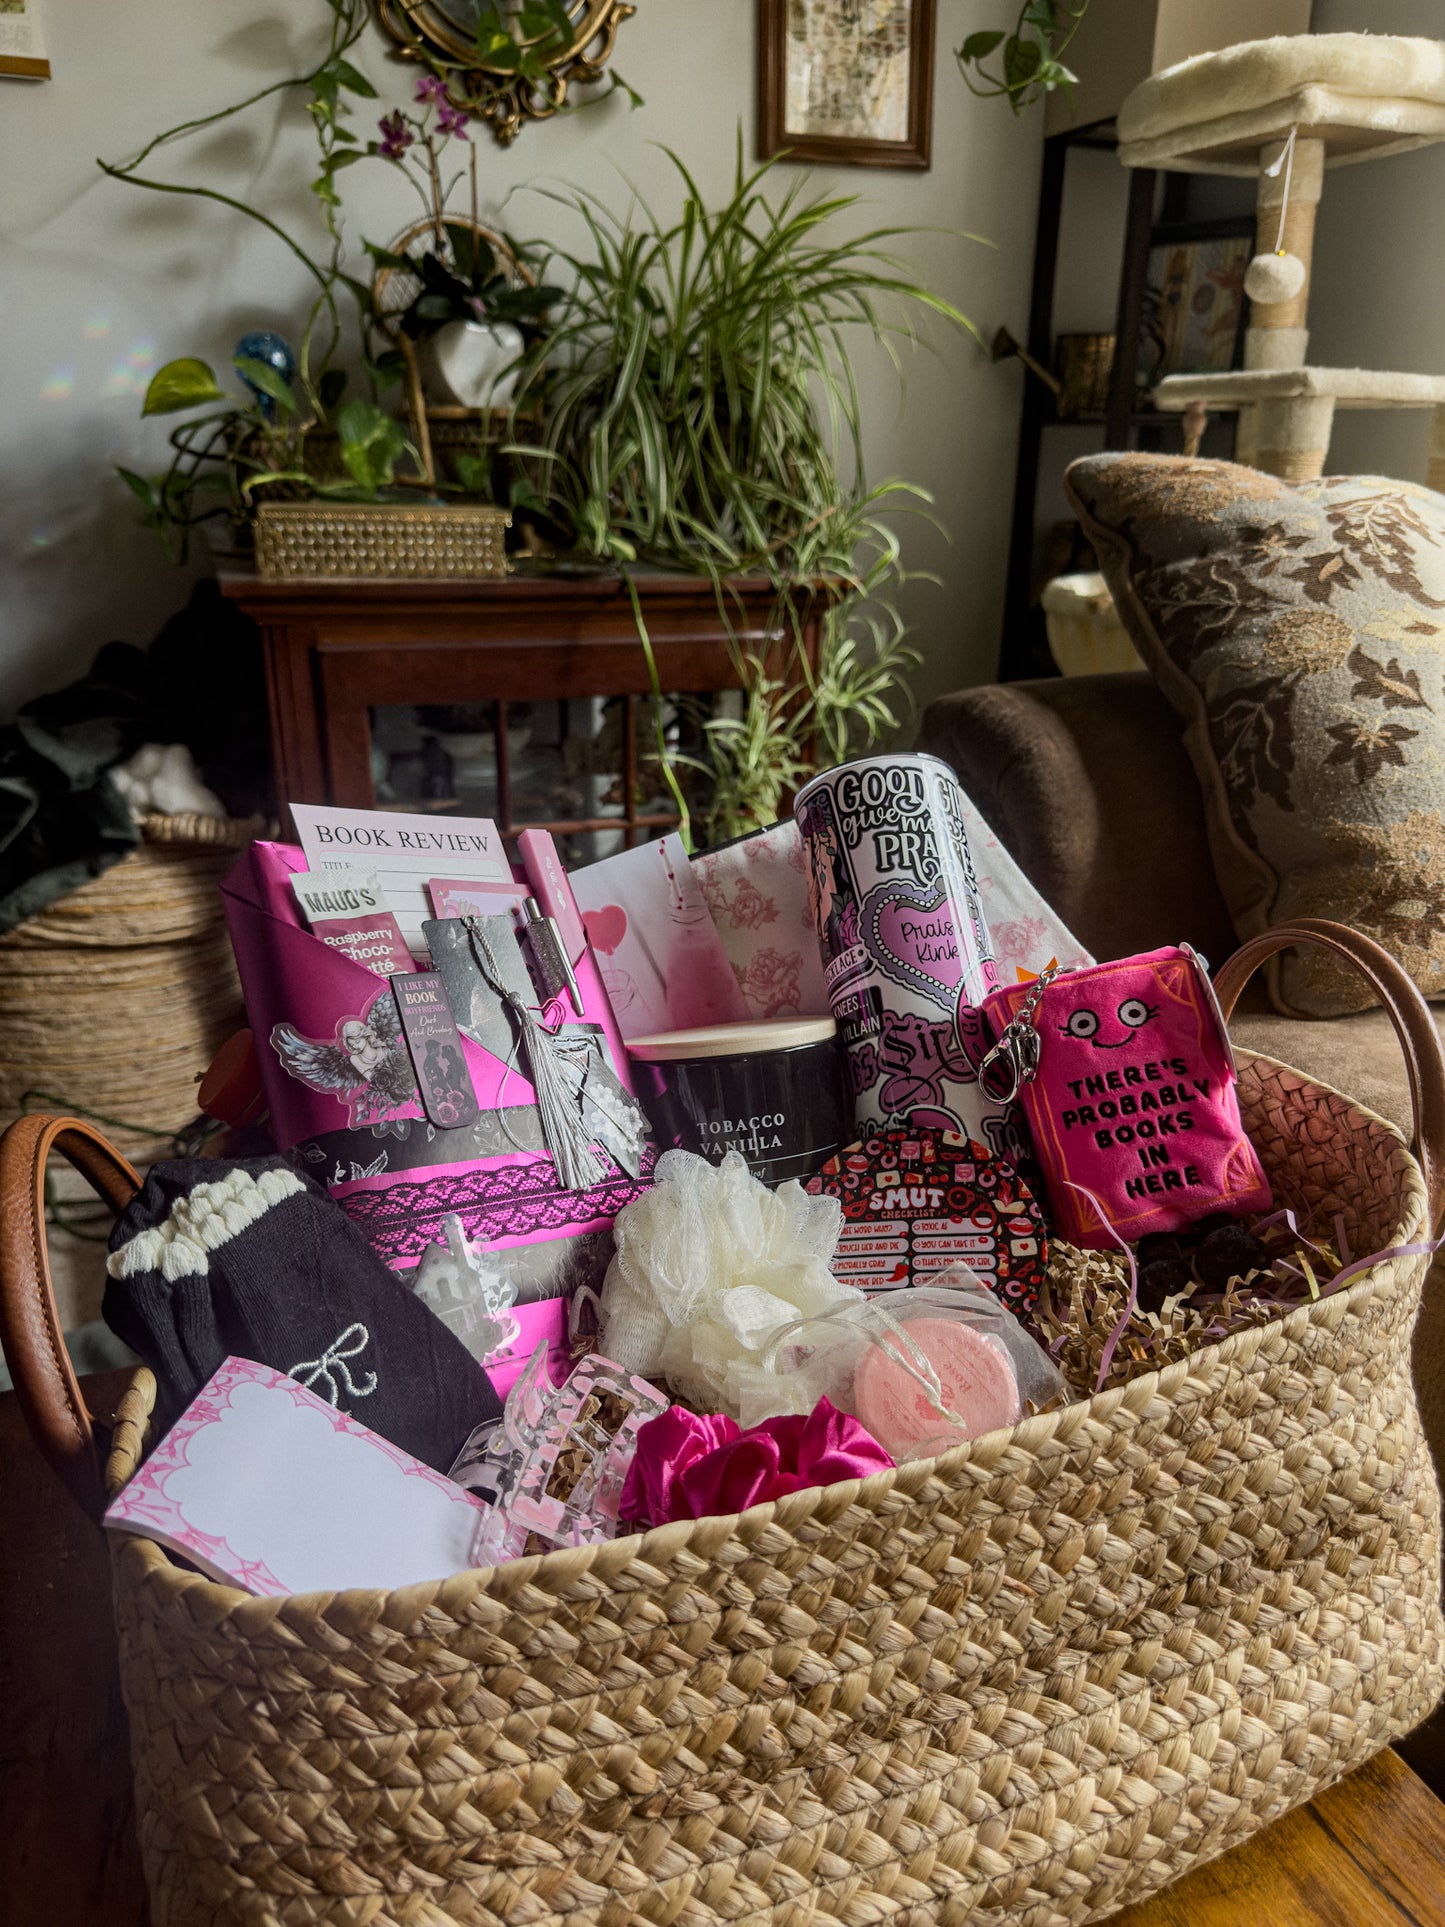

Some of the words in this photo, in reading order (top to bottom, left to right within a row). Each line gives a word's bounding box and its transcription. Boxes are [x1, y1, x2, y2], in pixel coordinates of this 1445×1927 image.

[837, 768, 927, 816] GOOD
[842, 804, 900, 845] give
[901, 815, 938, 833] me
[314, 825, 393, 848] BOOK
[397, 830, 489, 853] REVIEW
[303, 887, 377, 913] MAUD'S
[324, 929, 393, 946] Raspberry
[914, 940, 960, 964] Kink
[404, 981, 425, 991] LIKE
[425, 980, 439, 988] MY
[404, 1004, 447, 1015] BOYFRIENDS
[405, 991, 438, 1005] BOOK
[1066, 1058, 1188, 1100] THERE'S
[1061, 1079, 1209, 1131] PROBABLY
[696, 1113, 785, 1135] TOBACCO
[1094, 1111, 1195, 1149] BOOKS
[700, 1134, 783, 1155] VANILLA
[1137, 1143, 1170, 1168] IN
[1124, 1165, 1202, 1200] HERE
[868, 1187, 945, 1211] SMUT
[881, 1208, 936, 1220] CHECKLIST
[921, 1240, 937, 1249] YOU
[938, 1239, 951, 1248] CAN
[969, 1239, 976, 1248] IT
[838, 1260, 867, 1270] MORALLY
